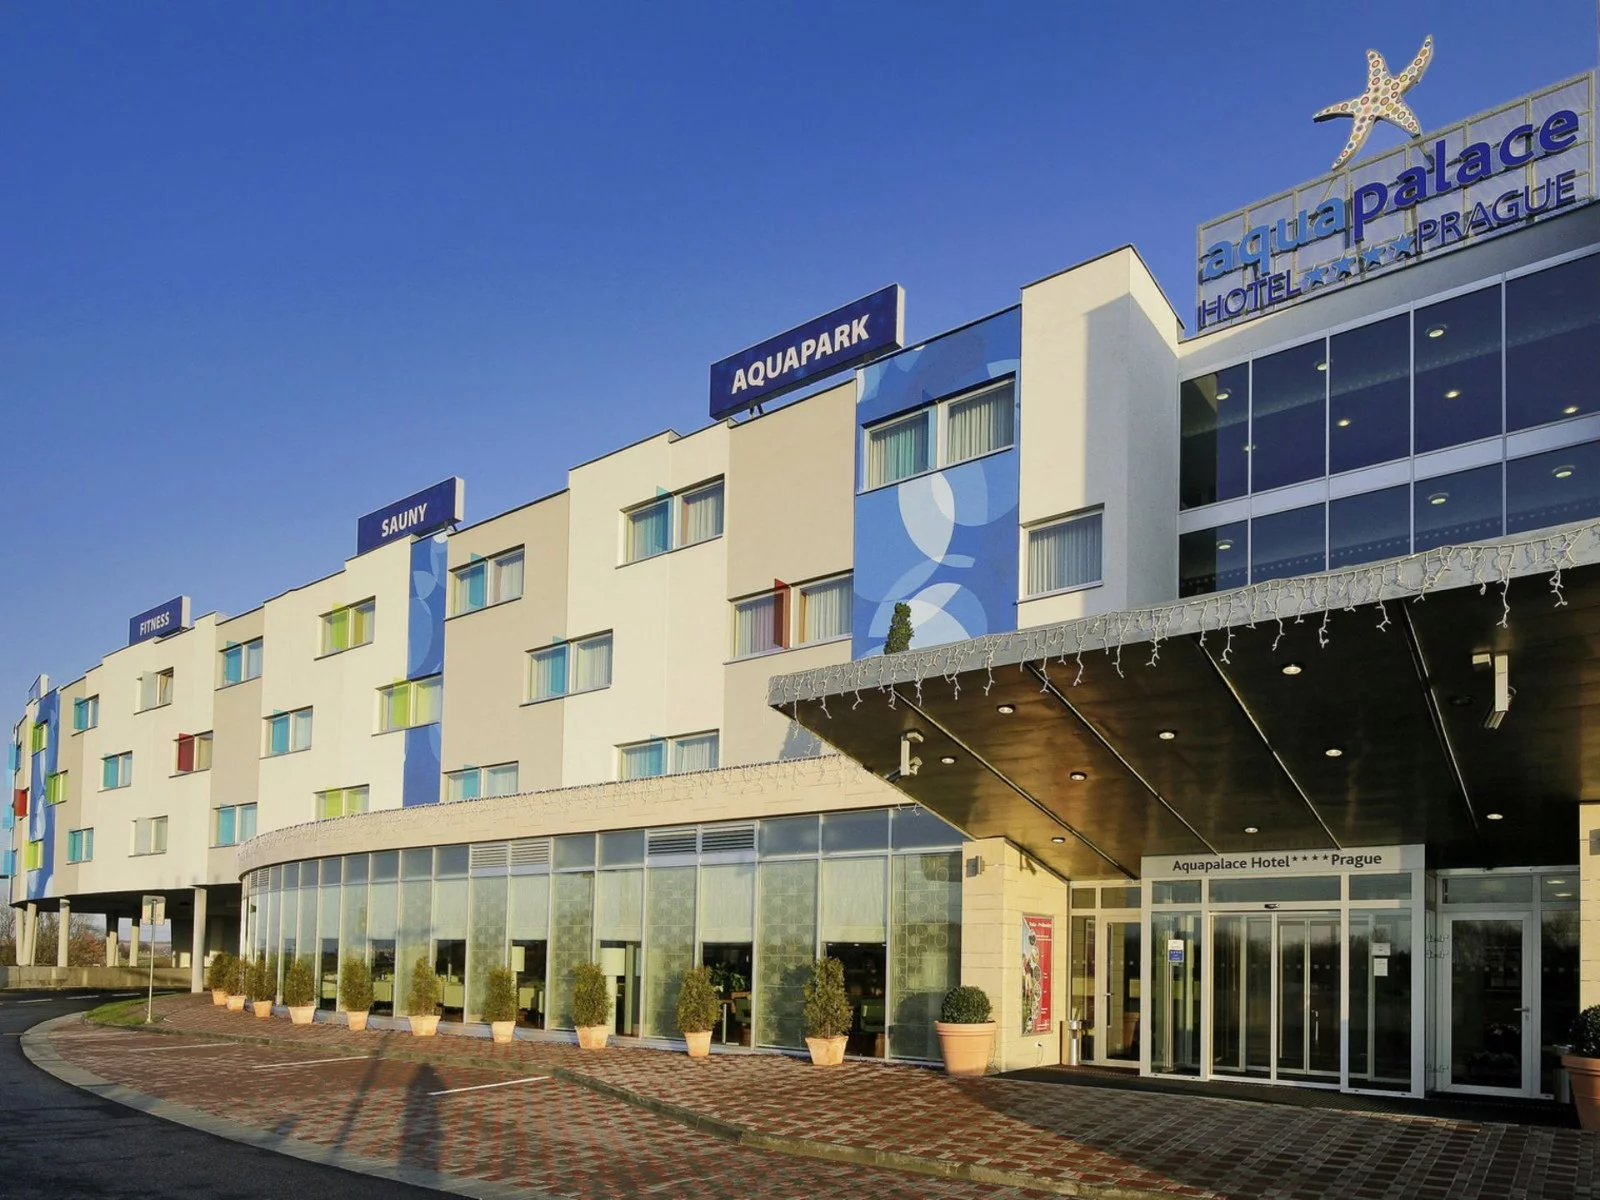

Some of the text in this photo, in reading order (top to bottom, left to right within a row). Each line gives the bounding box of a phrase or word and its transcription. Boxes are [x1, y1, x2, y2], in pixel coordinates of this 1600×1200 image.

[1204, 109, 1579, 277] aquapalace
[1201, 169, 1577, 326] HOTEL PRAGUE
[731, 314, 870, 395] AQUAPARK
[381, 502, 428, 537] SAUNY
[140, 611, 170, 636] FITNESS
[1172, 853, 1382, 873] Aquapalace Hotel Prague
